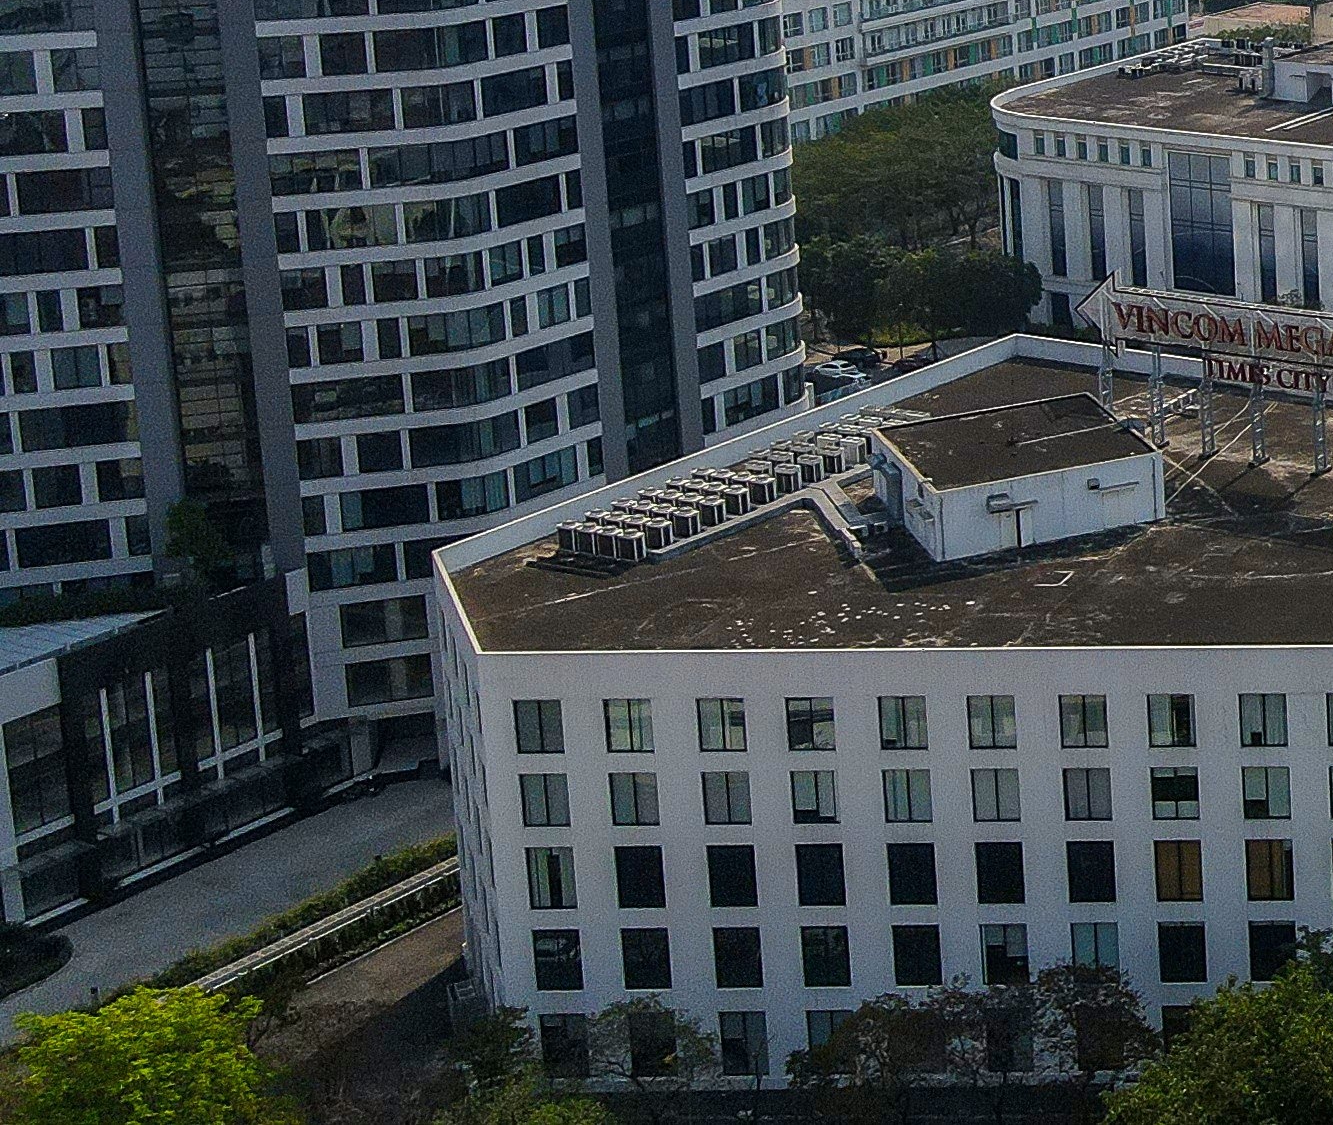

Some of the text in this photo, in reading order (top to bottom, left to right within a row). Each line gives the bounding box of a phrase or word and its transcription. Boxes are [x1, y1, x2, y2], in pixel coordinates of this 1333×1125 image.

[1111, 302, 1248, 346] VINCOM
[1206, 358, 1330, 393] TIMES CITY
